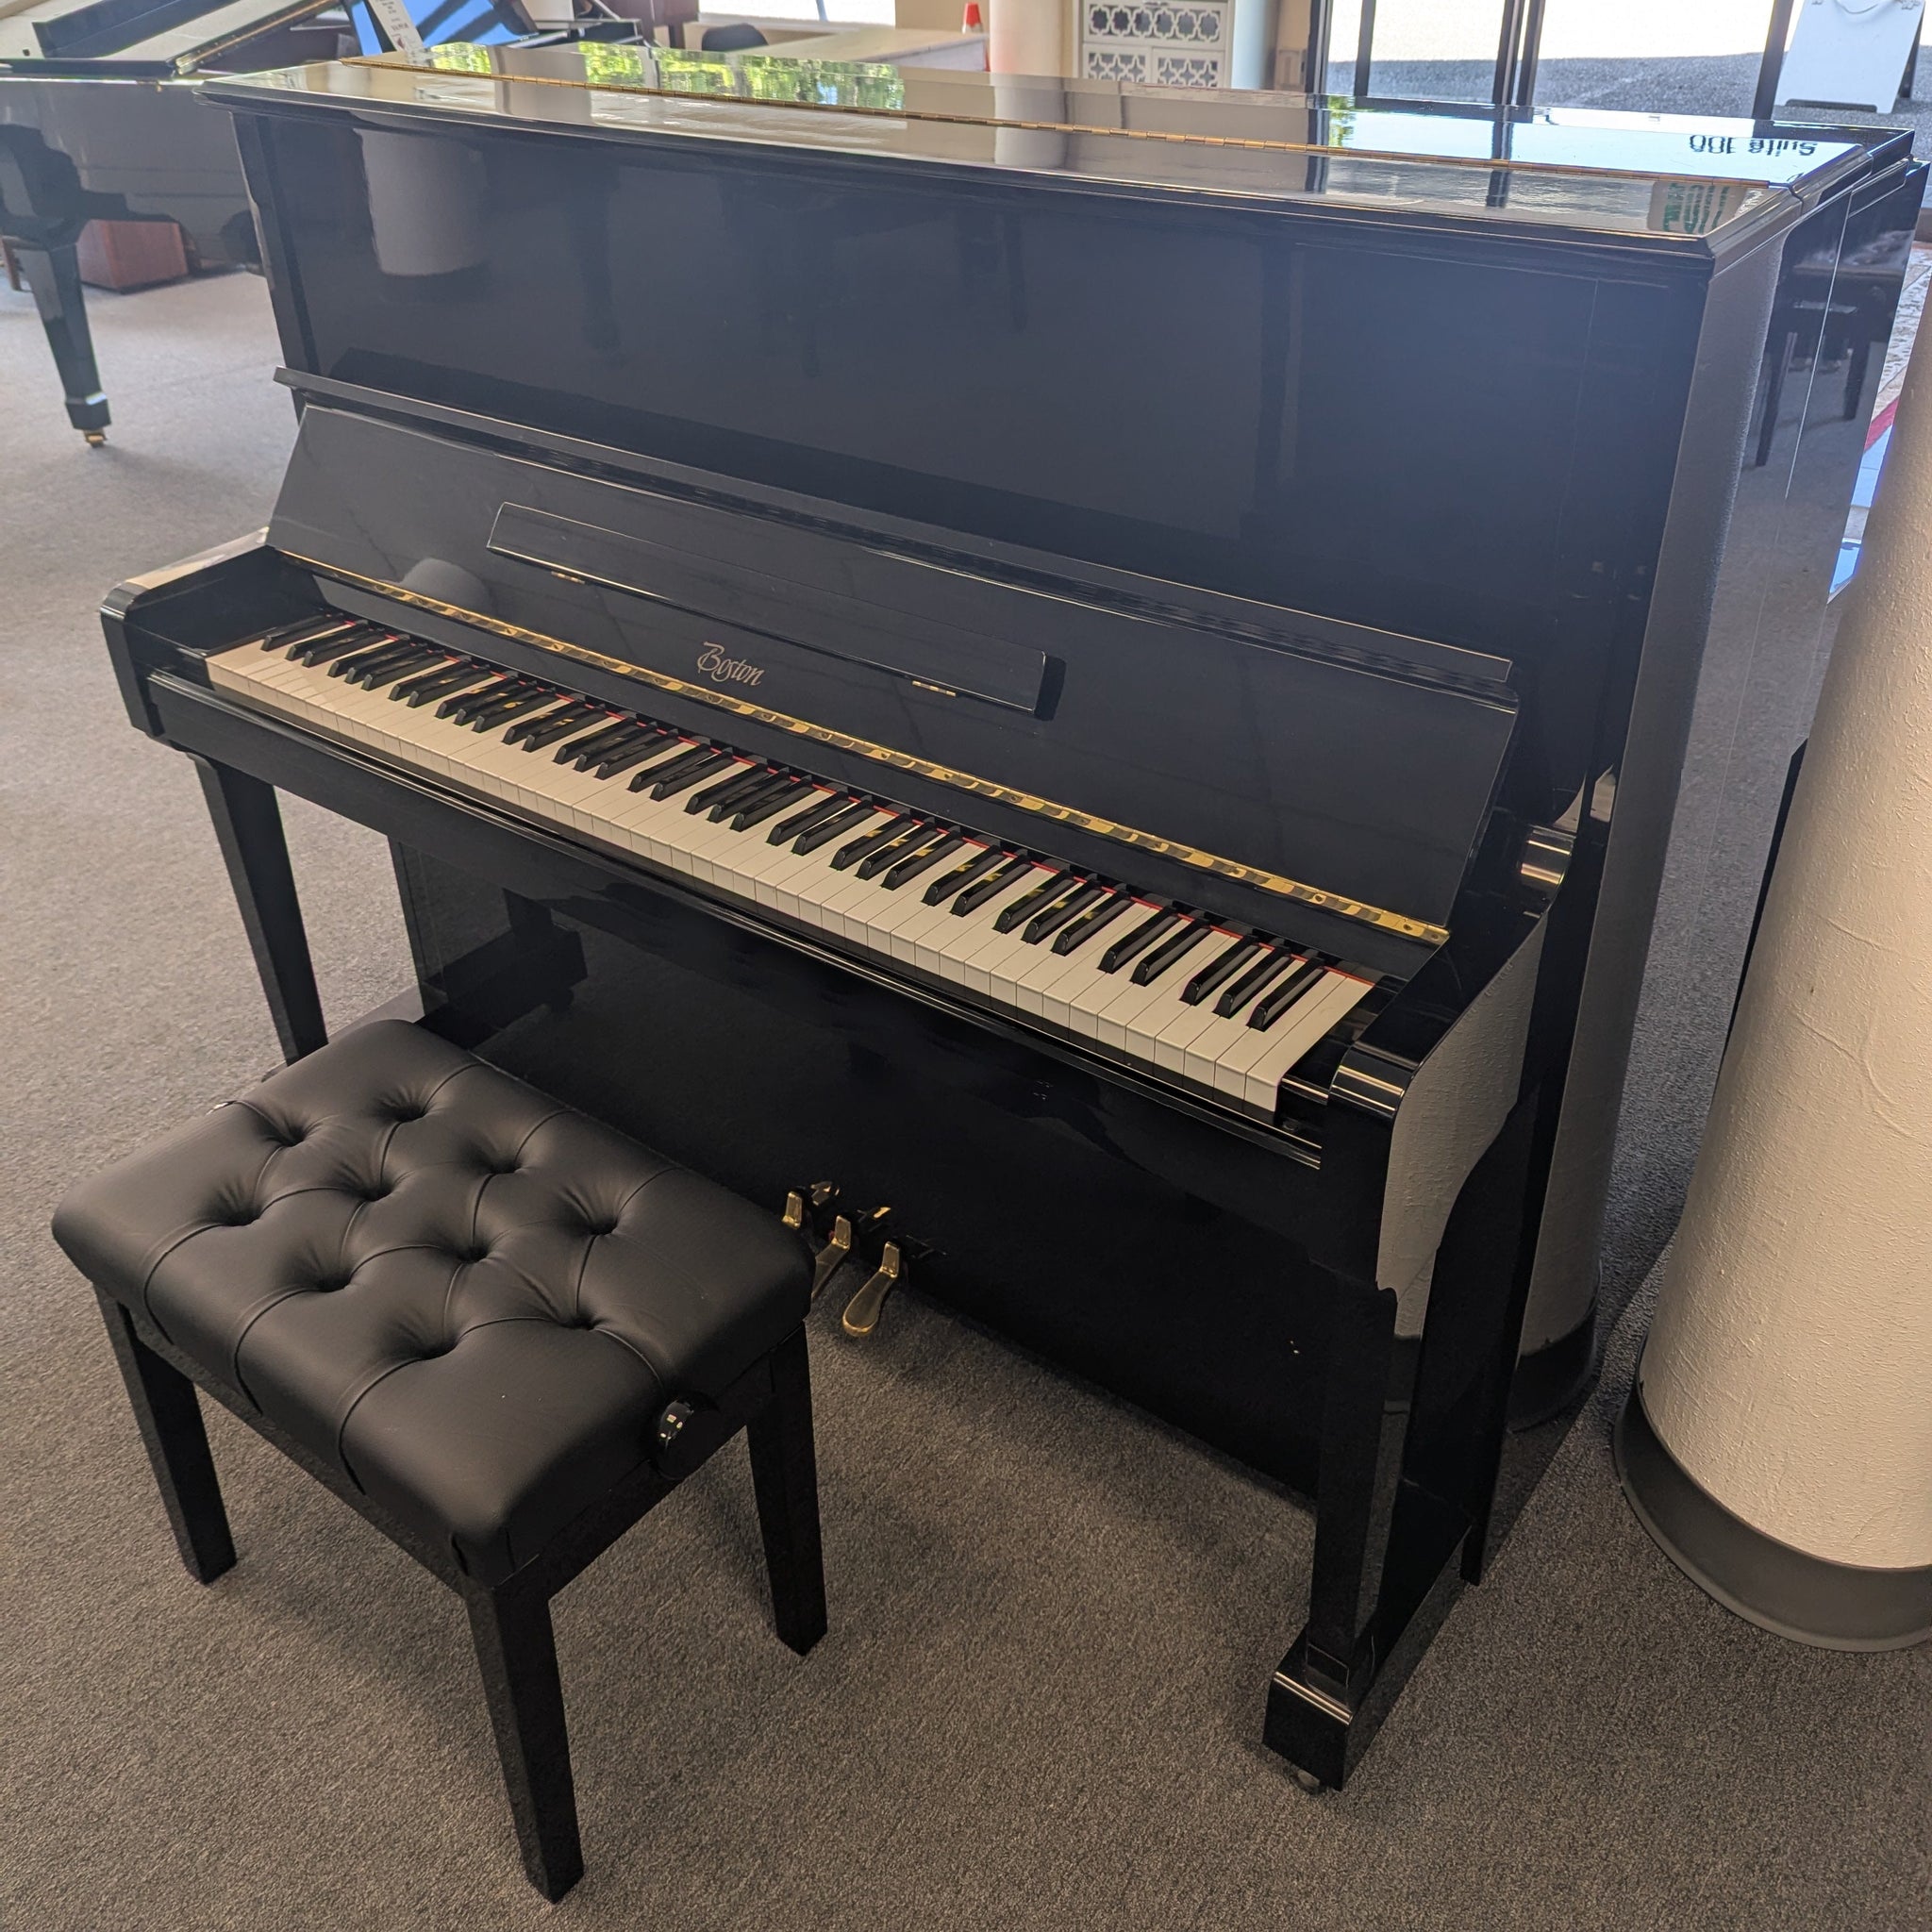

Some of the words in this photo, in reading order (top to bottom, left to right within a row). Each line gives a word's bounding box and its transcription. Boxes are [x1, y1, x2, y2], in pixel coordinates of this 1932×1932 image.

[1690, 134, 1736, 154] 100
[1749, 139, 1817, 157] Suite
[697, 641, 764, 686] Boston
